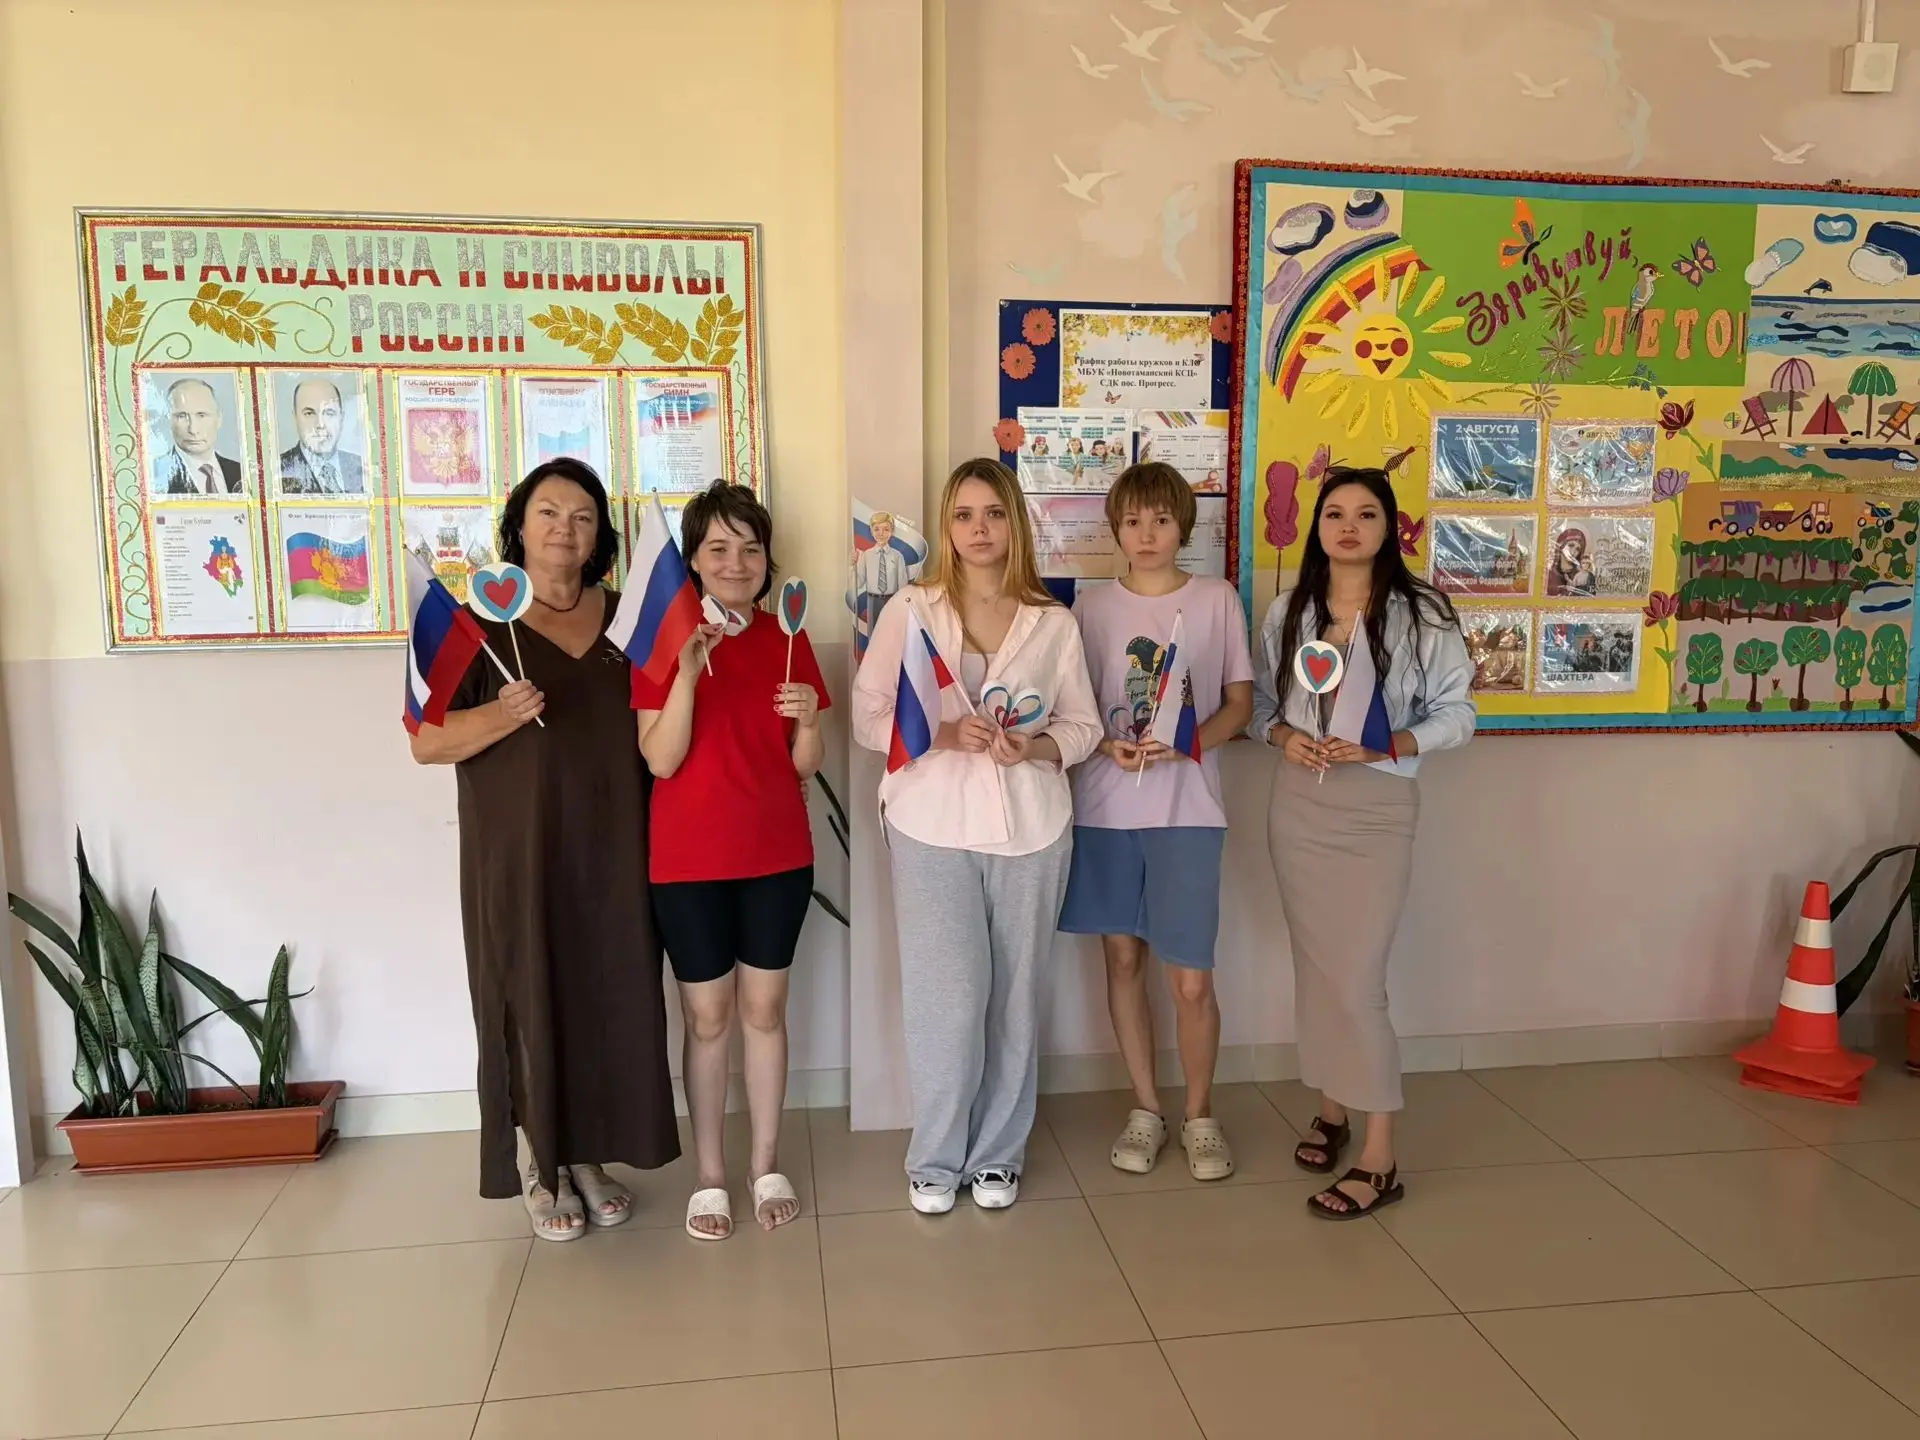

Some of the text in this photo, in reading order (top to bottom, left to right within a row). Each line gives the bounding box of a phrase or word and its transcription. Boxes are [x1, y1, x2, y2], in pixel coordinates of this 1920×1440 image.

[112, 229, 726, 295] ГЕРАЛЬДИКА И СИМВОЛЫ
[1594, 305, 1748, 365] ЛЕТО!
[1074, 356, 1106, 367] График
[1107, 358, 1137, 367] работы
[1139, 359, 1173, 368] кружков
[1077, 368, 1104, 376] МБУК
[1106, 369, 1173, 377] «Новотаманский
[644, 382, 707, 390] ГОСУДАРСТВЕННЫЙ
[1138, 380, 1176, 388] Прогресс.
[428, 387, 457, 396] ГЕРБ
[1455, 423, 1520, 434] 2 АВГУСТА
[1546, 673, 1595, 682] ШАХТЕРА
